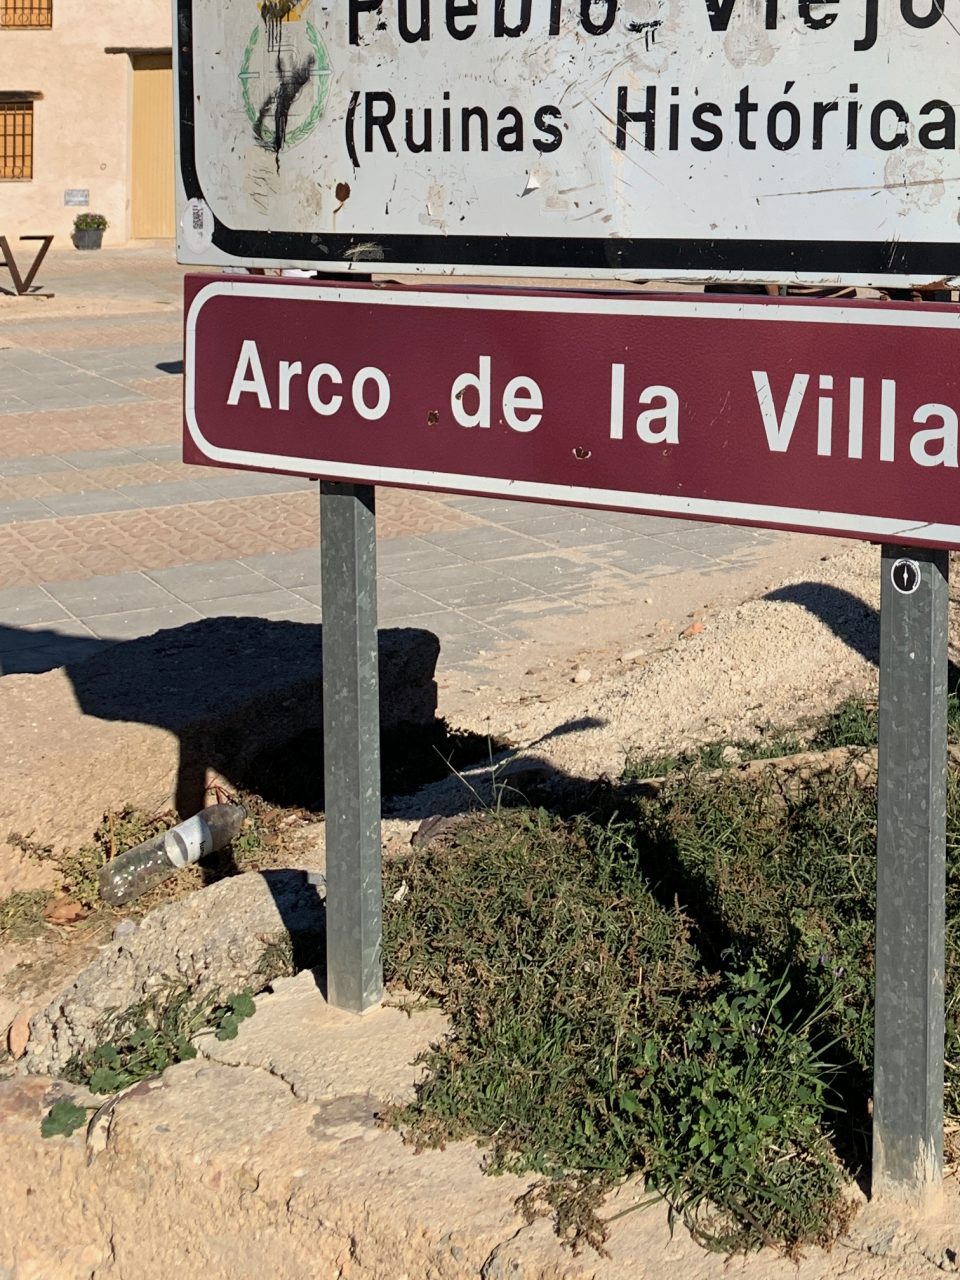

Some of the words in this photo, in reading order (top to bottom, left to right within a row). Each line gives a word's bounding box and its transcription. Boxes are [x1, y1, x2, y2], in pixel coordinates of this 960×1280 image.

[345, 89, 564, 168] (Ruinas
[226, 339, 392, 422] Arco
[450, 355, 545, 434] de
[609, 363, 681, 446] la
[751, 370, 960, 469] Villa
